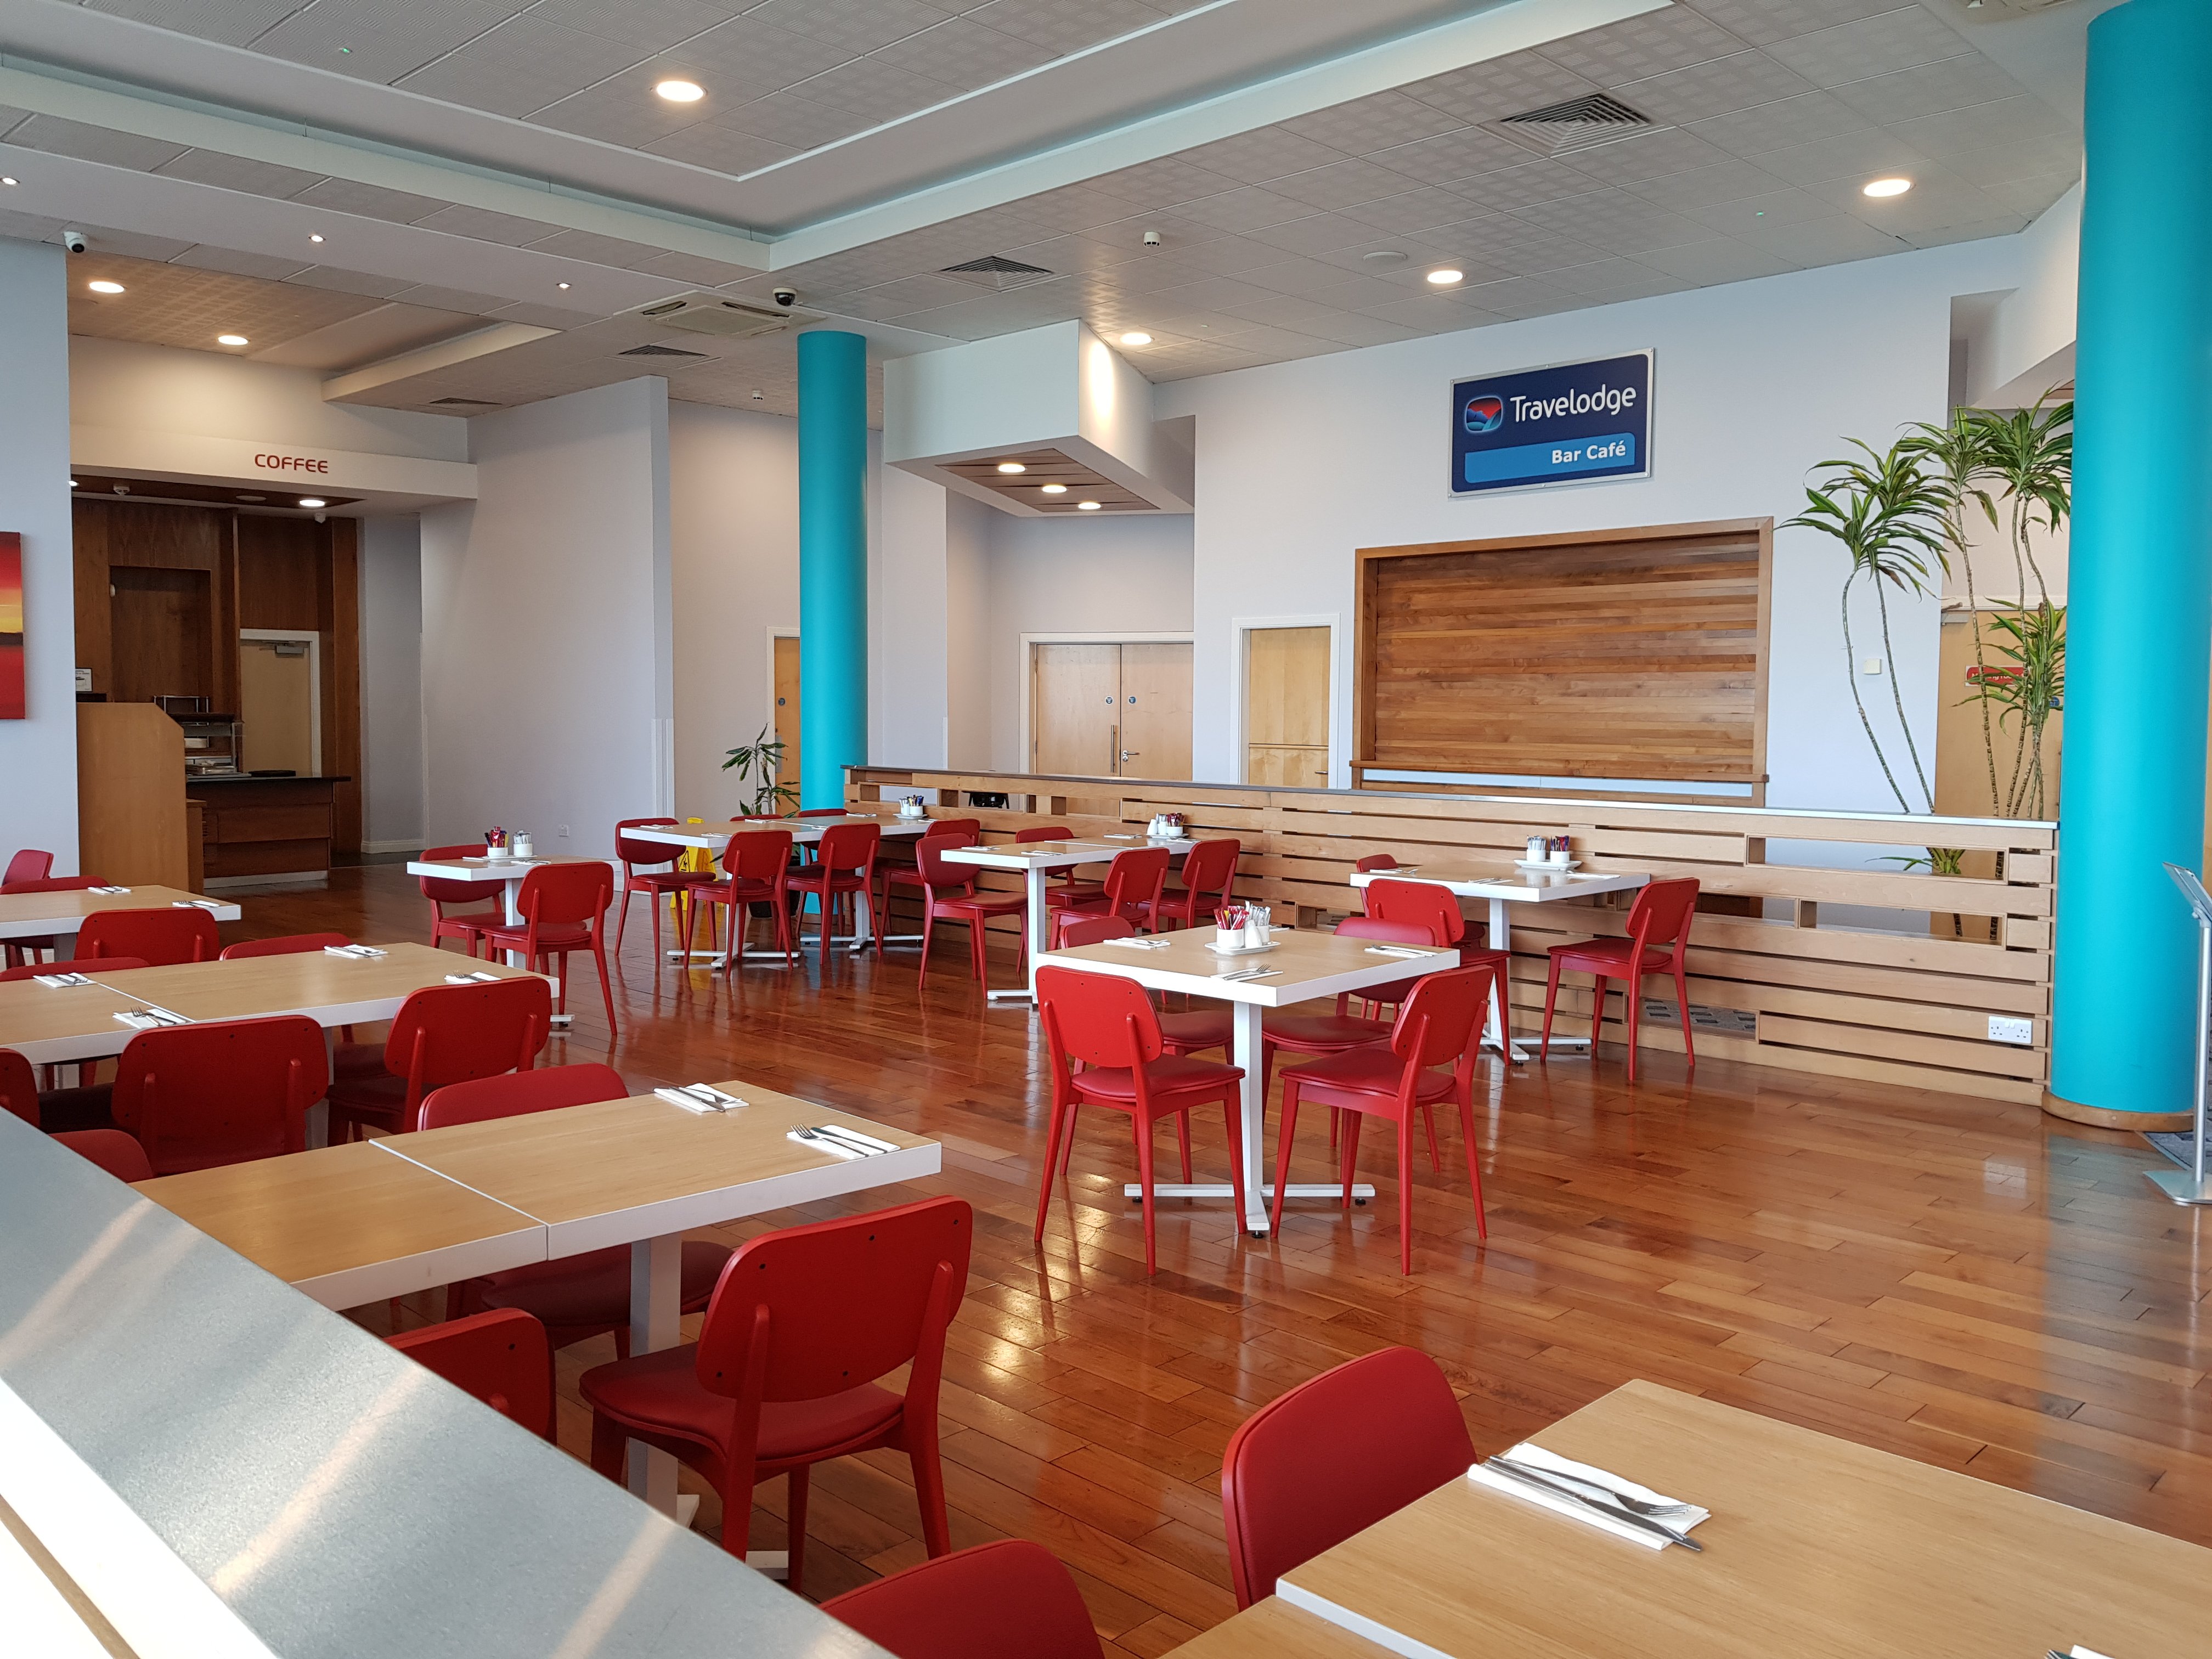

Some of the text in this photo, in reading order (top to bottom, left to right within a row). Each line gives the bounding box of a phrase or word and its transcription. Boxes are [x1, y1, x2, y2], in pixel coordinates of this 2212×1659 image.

[1510, 384, 1637, 422] Travelodge
[254, 454, 328, 473] COFFEE
[1552, 440, 1626, 464] Bar Café
